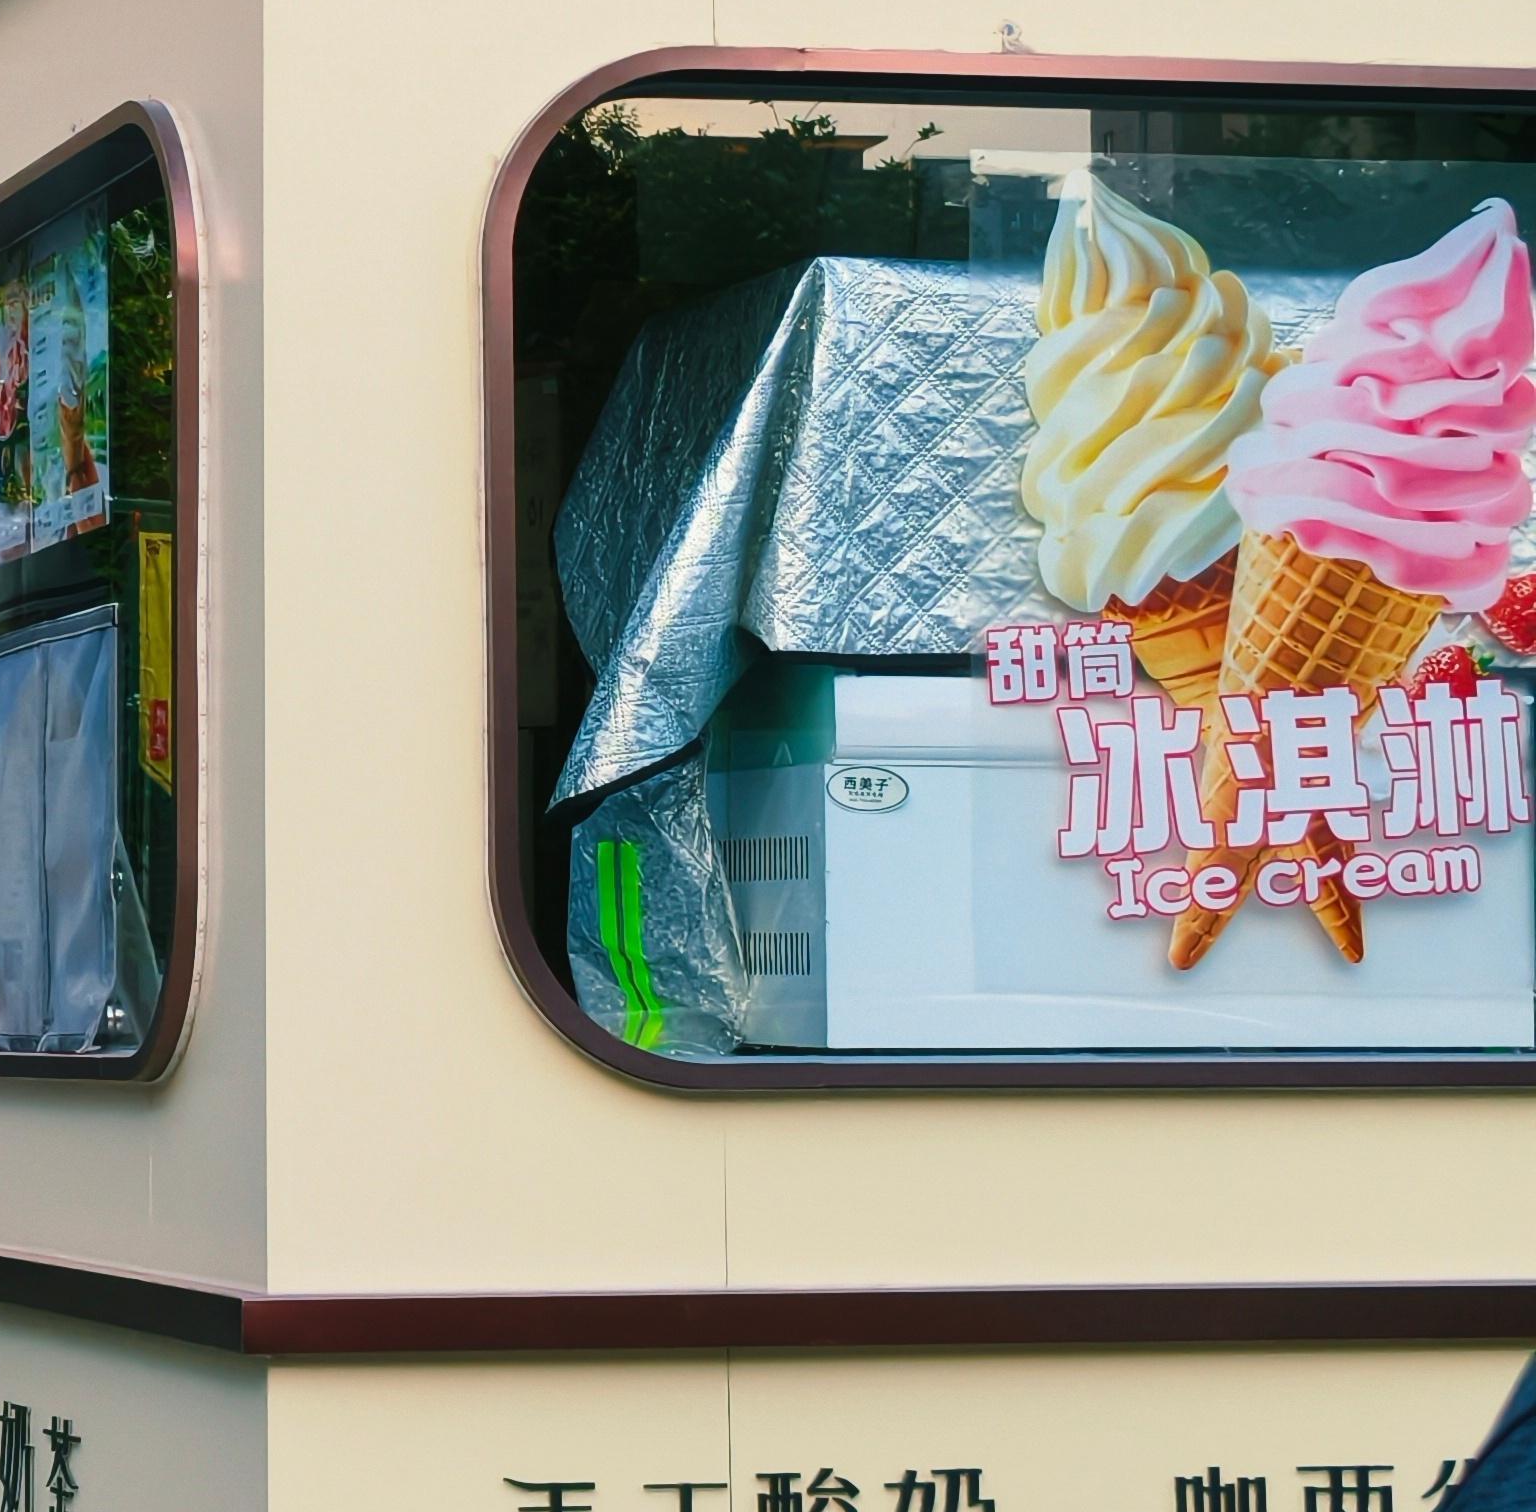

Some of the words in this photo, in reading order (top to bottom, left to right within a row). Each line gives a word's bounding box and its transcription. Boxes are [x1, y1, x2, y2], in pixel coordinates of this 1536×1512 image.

[986, 621, 1134, 704] 甜筒
[1057, 680, 1532, 859] 冰淇淋
[1106, 856, 1240, 920] Ice
[1256, 845, 1482, 907] cream
